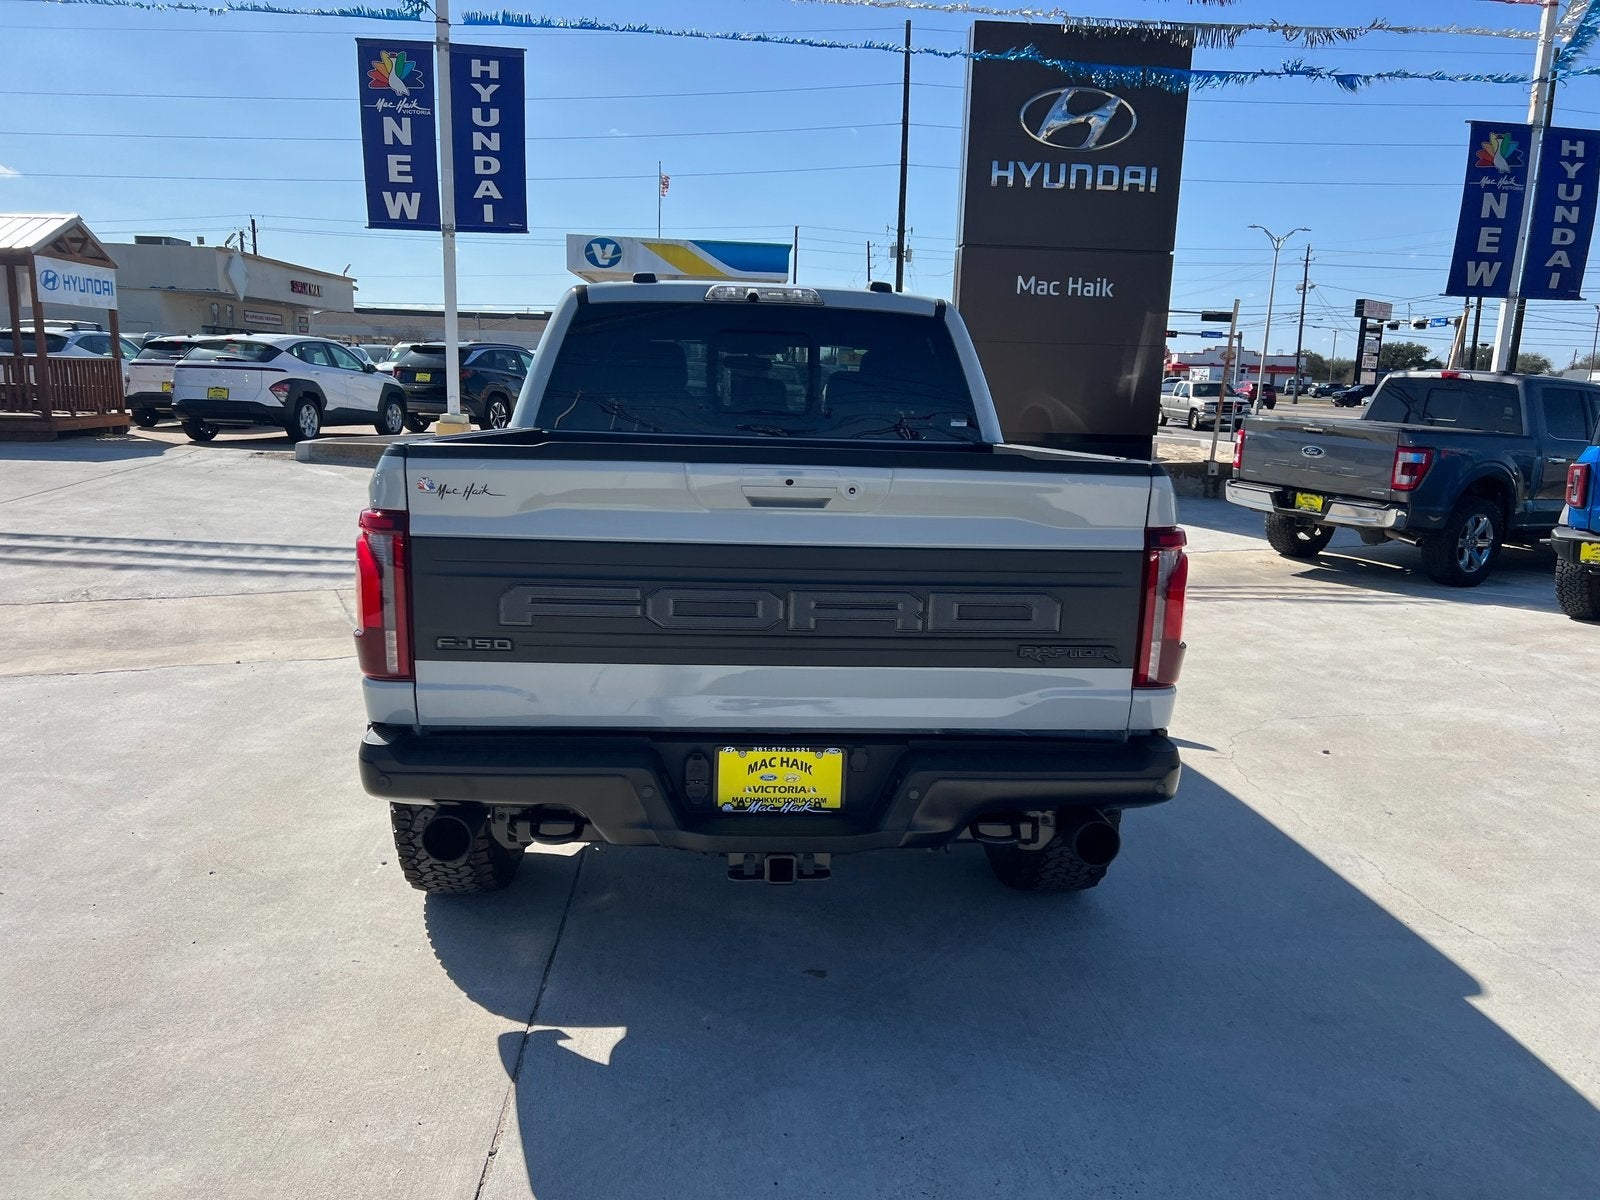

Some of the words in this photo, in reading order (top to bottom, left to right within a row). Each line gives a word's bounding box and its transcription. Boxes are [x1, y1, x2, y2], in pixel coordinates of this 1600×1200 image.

[374, 98, 396, 112] Mac
[396, 97, 426, 113] Haik
[470, 59, 503, 222] HYUNDAI
[382, 116, 421, 220] NEW
[991, 160, 1158, 193] HYUNDAI
[1544, 139, 1585, 289] HYUNDAI
[1466, 192, 1508, 287] NEW
[62, 274, 114, 296] HYUNDAI
[1016, 275, 1059, 296] Mac
[1067, 277, 1114, 298] Haik
[436, 484, 461, 500] Mac
[462, 482, 498, 500] Haik
[499, 584, 1062, 634] FORD
[436, 637, 512, 650] F-150
[1018, 645, 1121, 664] RAPTOR
[747, 757, 776, 775] MAC
[780, 757, 812, 776] HAIK
[752, 785, 807, 794] VICTORIA
[731, 796, 828, 804] MACHAIKVICTORIA.COM
[746, 801, 778, 813] Mac
[780, 801, 818, 813] Haik
